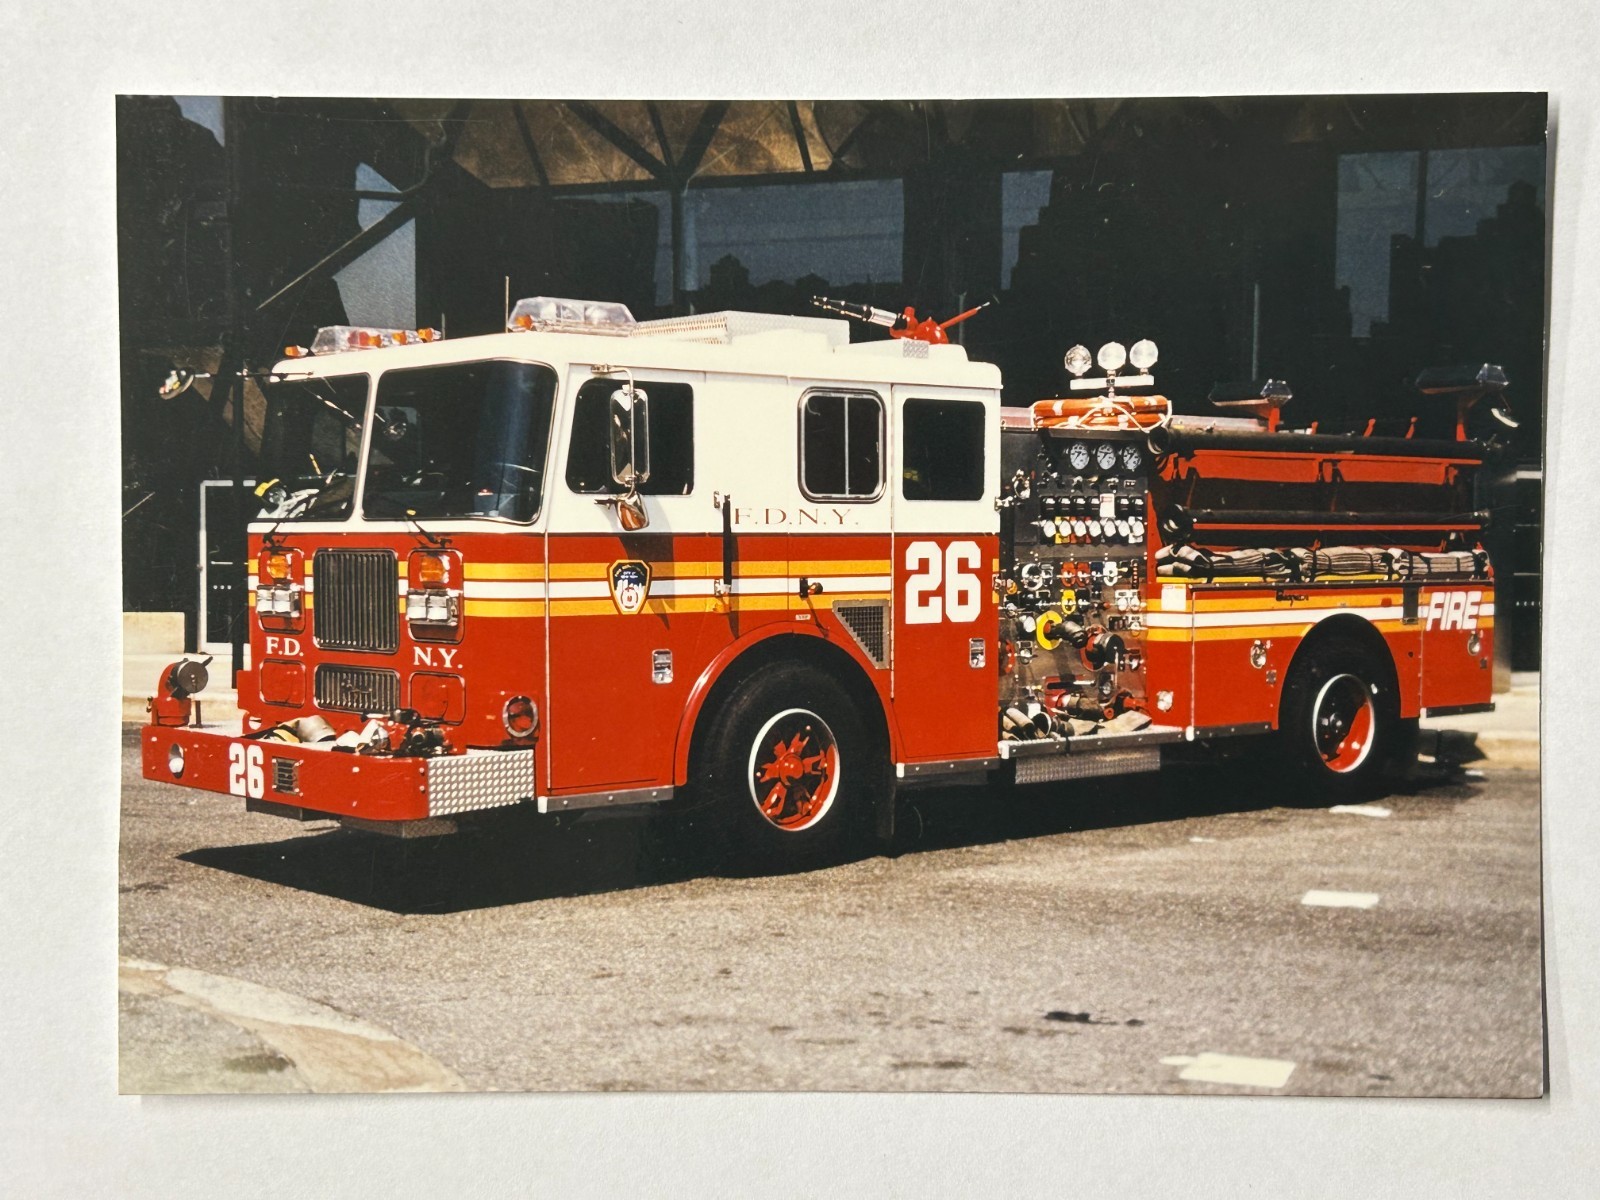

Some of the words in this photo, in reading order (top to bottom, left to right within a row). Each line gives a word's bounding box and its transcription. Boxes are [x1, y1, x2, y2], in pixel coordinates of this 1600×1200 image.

[735, 507, 859, 525] F.D.N.Y.
[905, 541, 981, 624] 26
[1426, 591, 1482, 631] FIRE
[265, 636, 305, 657] F.D.
[413, 646, 463, 669] N.Y.
[229, 742, 265, 797] 26
